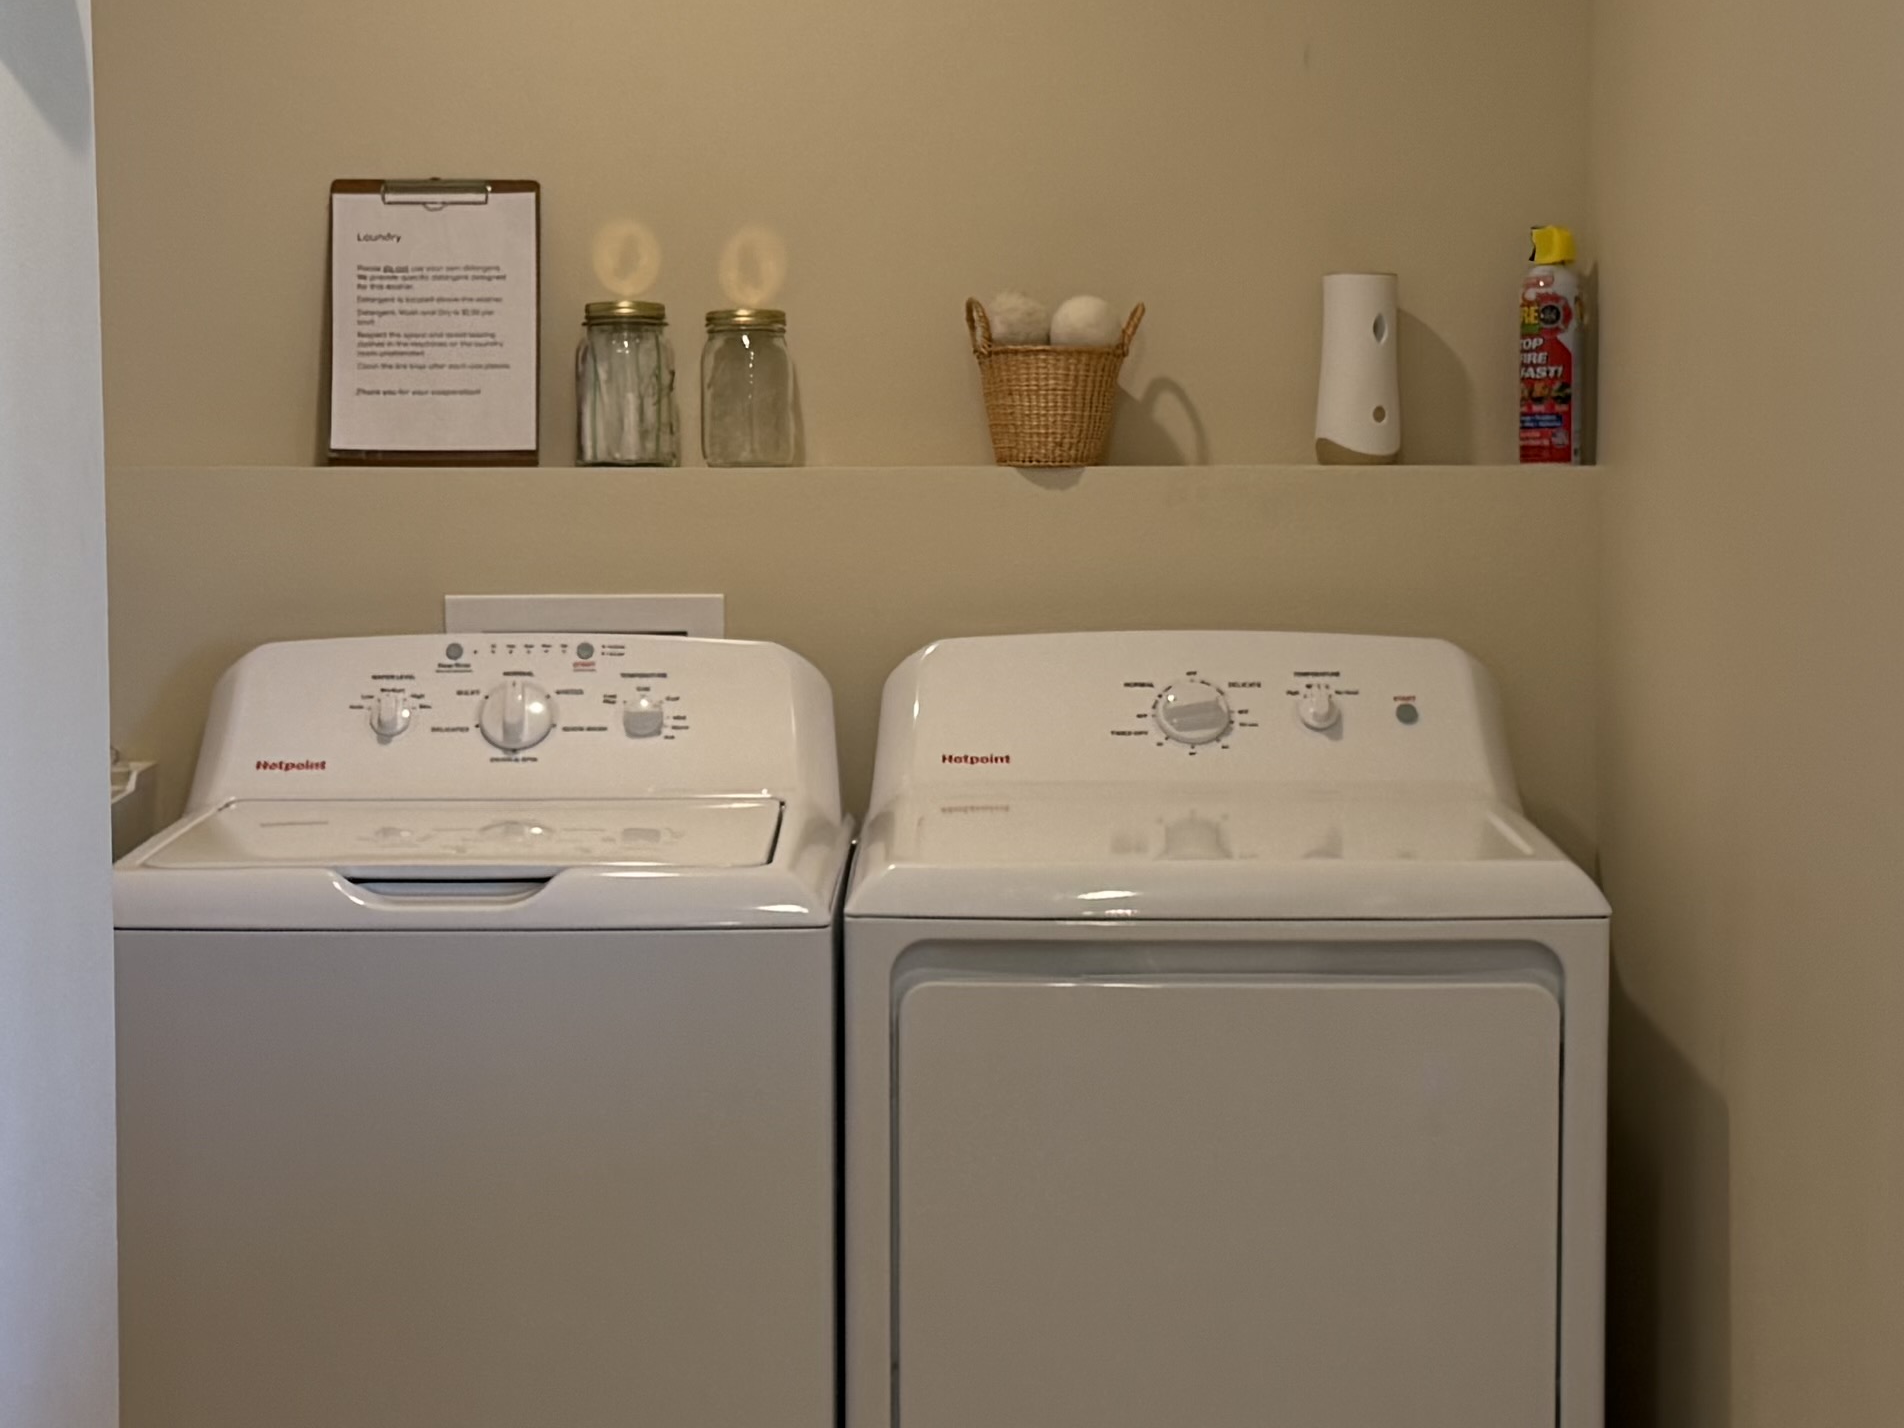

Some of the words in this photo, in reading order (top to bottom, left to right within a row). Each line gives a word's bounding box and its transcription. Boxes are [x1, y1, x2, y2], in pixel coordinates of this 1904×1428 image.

[357, 233, 401, 243] Laundry
[1520, 367, 1563, 378] AST!
[941, 754, 1010, 765] Hotpoint
[256, 760, 326, 771] Hotpoint
